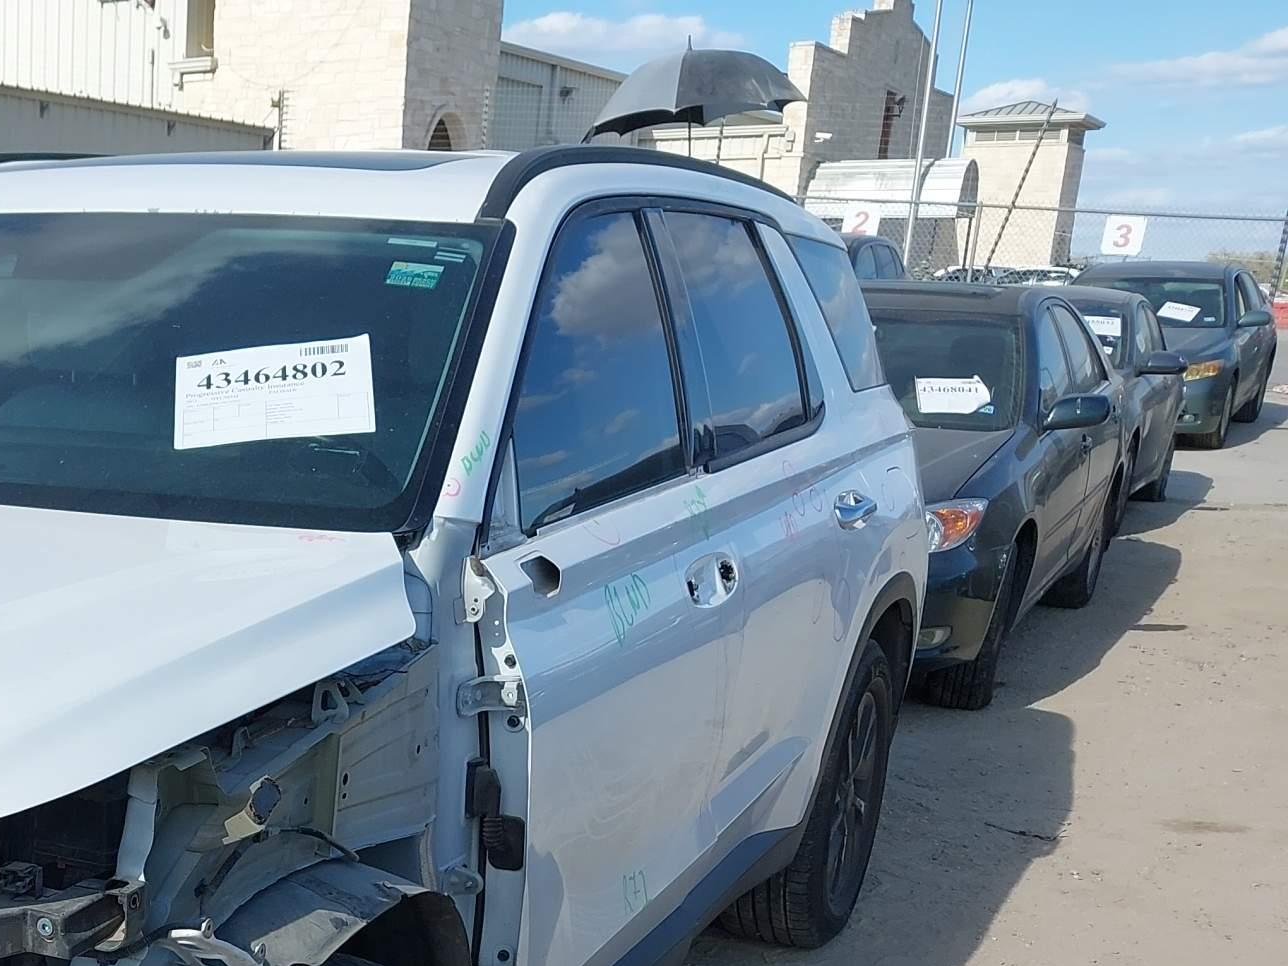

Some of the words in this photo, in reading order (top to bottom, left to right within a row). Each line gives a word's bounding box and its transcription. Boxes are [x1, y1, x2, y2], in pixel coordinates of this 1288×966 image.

[852, 211, 869, 234] 2
[1113, 223, 1133, 248] 3
[197, 359, 346, 390] 43464802
